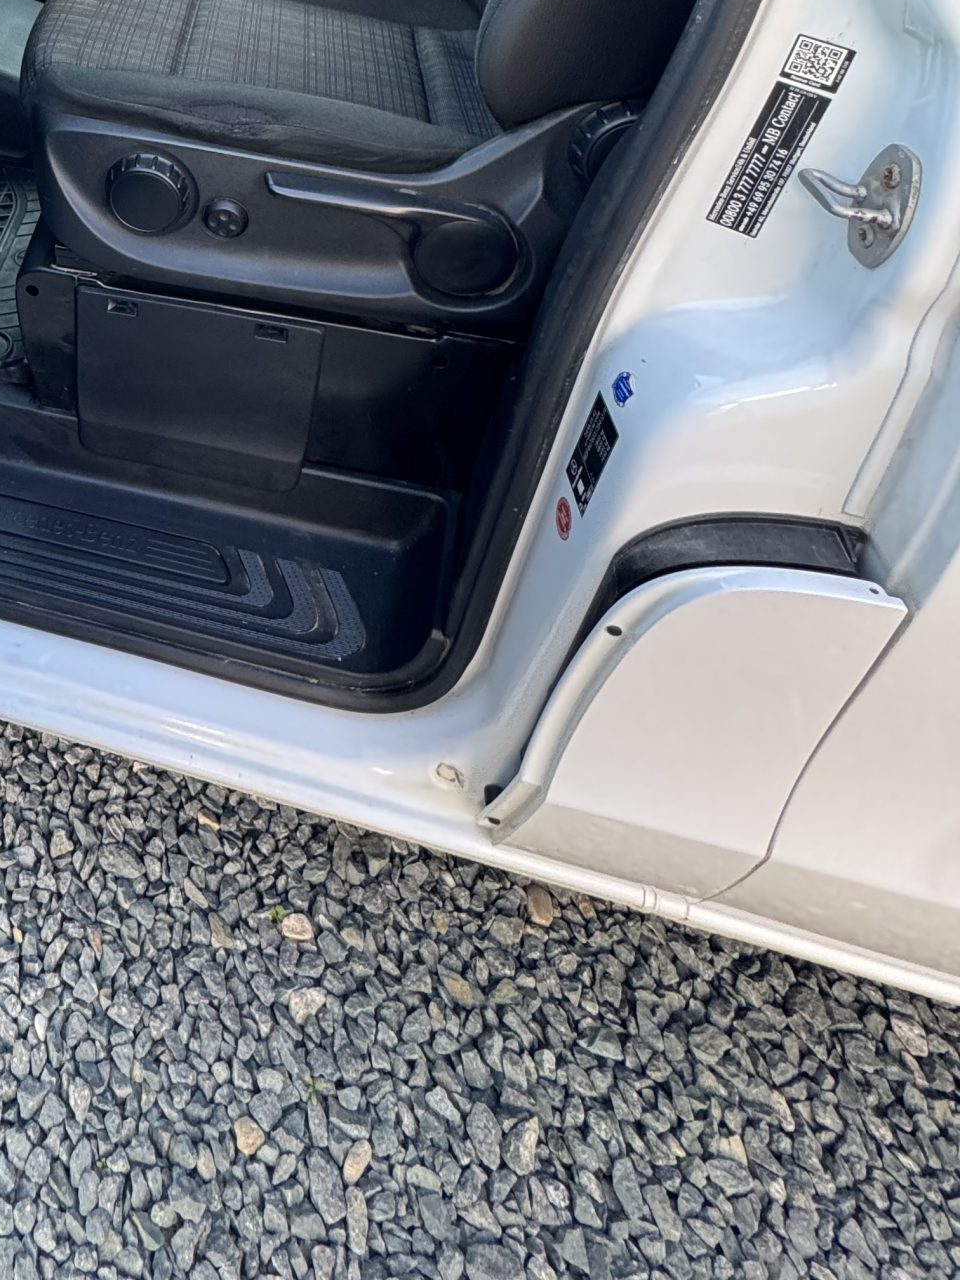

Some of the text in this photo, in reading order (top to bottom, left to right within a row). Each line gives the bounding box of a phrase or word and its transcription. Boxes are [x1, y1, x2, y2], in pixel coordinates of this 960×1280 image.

[769, 90, 801, 129] Contact
[760, 126, 782, 146] MB
[774, 147, 789, 159] 16
[744, 152, 768, 177] 7777
[768, 158, 783, 171] 74
[762, 169, 777, 182] 30
[735, 174, 756, 194] 777
[756, 179, 771, 192] 95
[732, 191, 747, 202] 3
[751, 190, 765, 203] 69
[718, 198, 743, 227] 00800
[743, 200, 759, 217] +49
